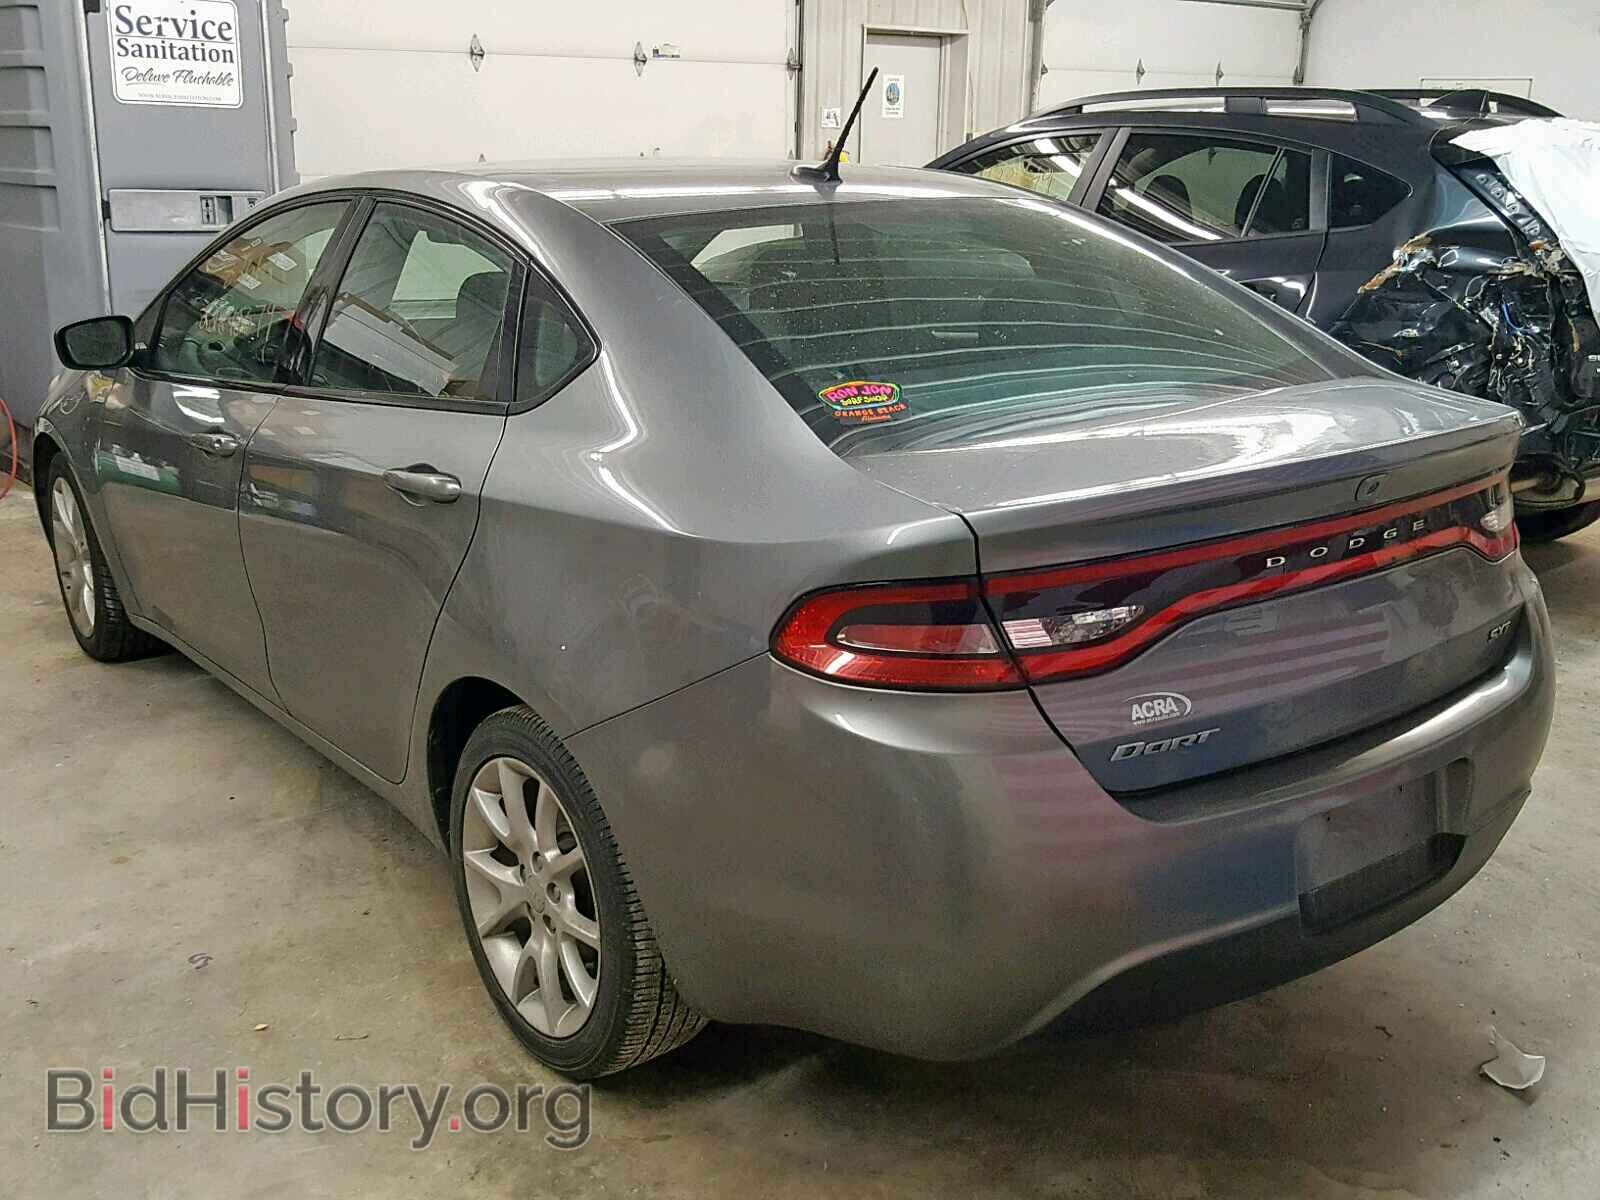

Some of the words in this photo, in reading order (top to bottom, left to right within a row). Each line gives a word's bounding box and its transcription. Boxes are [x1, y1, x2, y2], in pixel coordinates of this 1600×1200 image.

[115, 5, 233, 41] Service
[117, 38, 235, 64] Sanitation
[121, 66, 171, 83] Deluxe
[172, 69, 234, 86] Flushable
[826, 386, 859, 402] RON
[861, 385, 892, 395] JON
[1266, 518, 1426, 568] DODGE
[1131, 697, 1179, 721] ACRA
